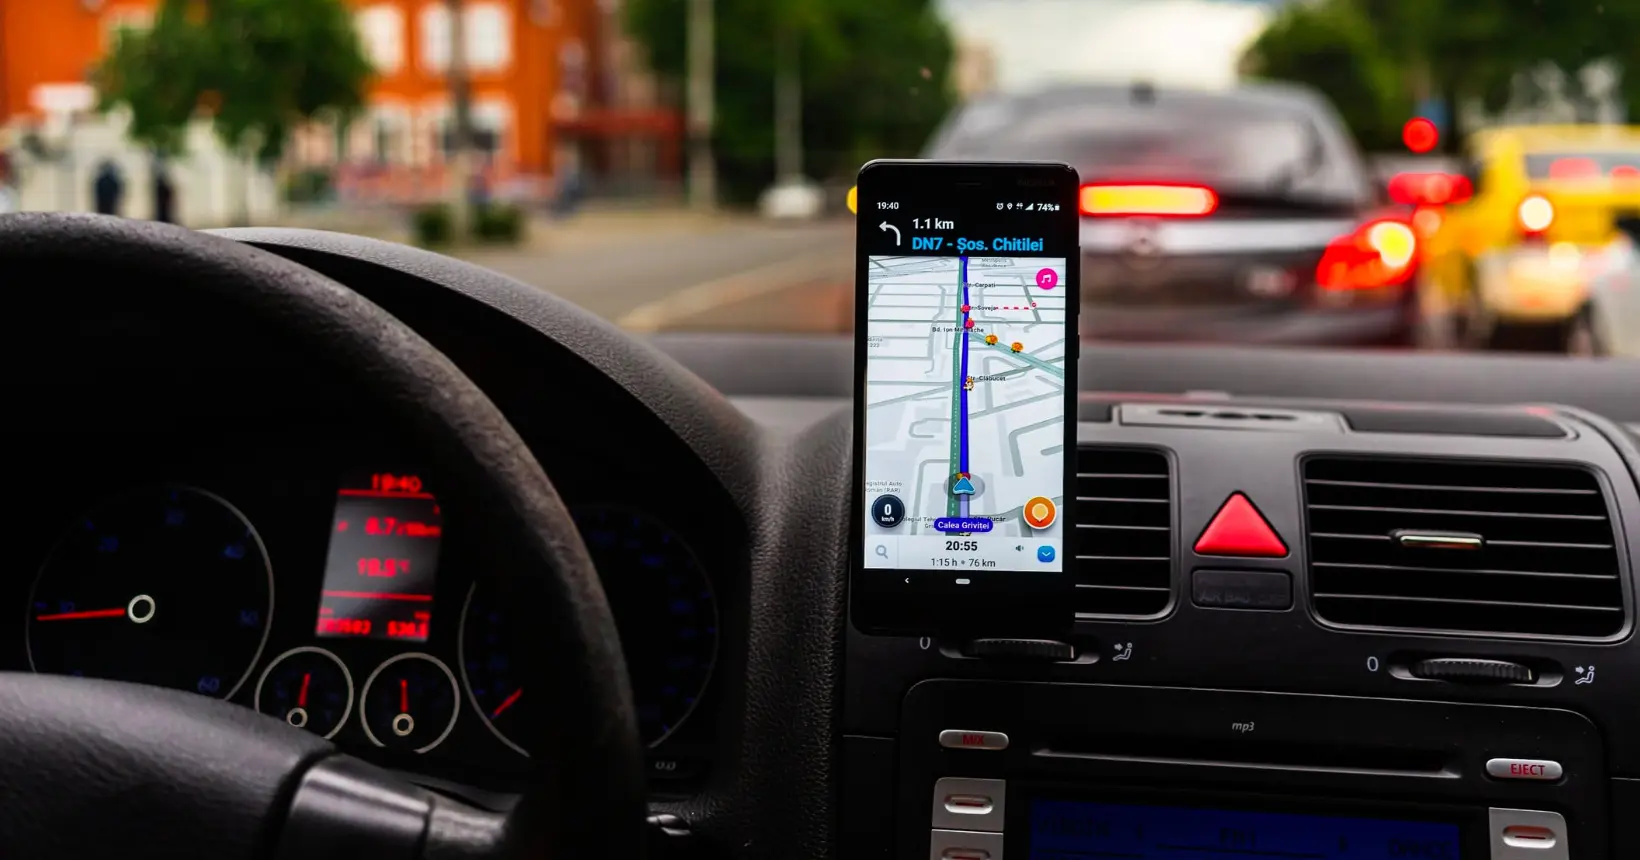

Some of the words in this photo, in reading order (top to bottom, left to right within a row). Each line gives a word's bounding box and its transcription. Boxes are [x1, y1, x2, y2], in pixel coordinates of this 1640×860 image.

[876, 201, 899, 210] 19:40
[1037, 203, 1054, 211] 74%
[912, 218, 931, 229] 1.1
[934, 217, 954, 230] km
[912, 237, 943, 250] DN7
[992, 237, 1044, 251] Chitilei
[884, 503, 892, 516] 0
[937, 521, 959, 530] Calea
[945, 540, 978, 551] 20:55
[931, 558, 950, 567] 1:15
[951, 558, 958, 567] h
[968, 559, 980, 568] 76
[981, 559, 996, 568] km
[1367, 656, 1379, 671] 0
[1231, 721, 1255, 733] mp3
[962, 734, 984, 746] MIX
[1510, 763, 1546, 776] EJECT
